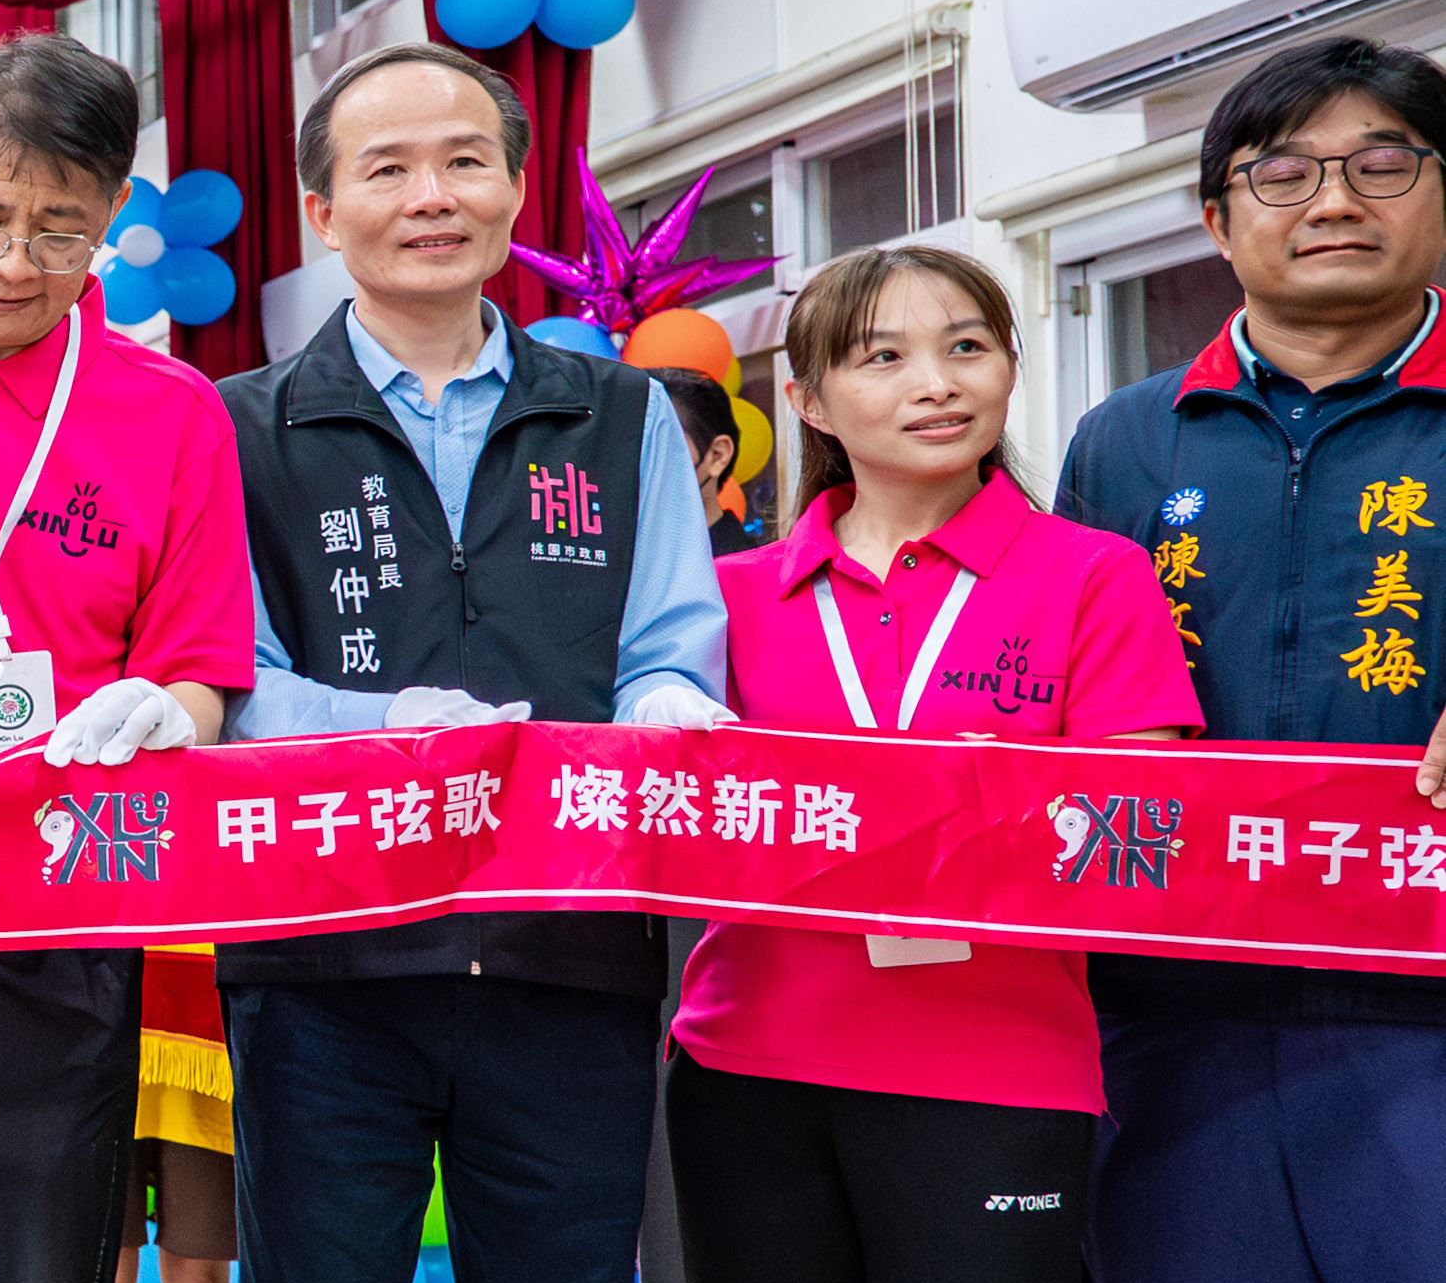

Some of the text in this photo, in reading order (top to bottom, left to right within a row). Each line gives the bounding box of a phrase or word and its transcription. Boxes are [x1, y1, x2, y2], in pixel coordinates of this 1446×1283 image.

[16, 507, 120, 550] XIN LU
[361, 474, 403, 590] 教育局長
[530, 542, 606, 561] 桃園市政府
[319, 506, 381, 675] 劉仲成
[1339, 475, 1436, 697] 陳美梅
[939, 670, 1055, 705] XIN LU
[215, 763, 862, 865] 甲子弦歌 燦然新路
[1017, 1192, 1062, 1212] YONEX
